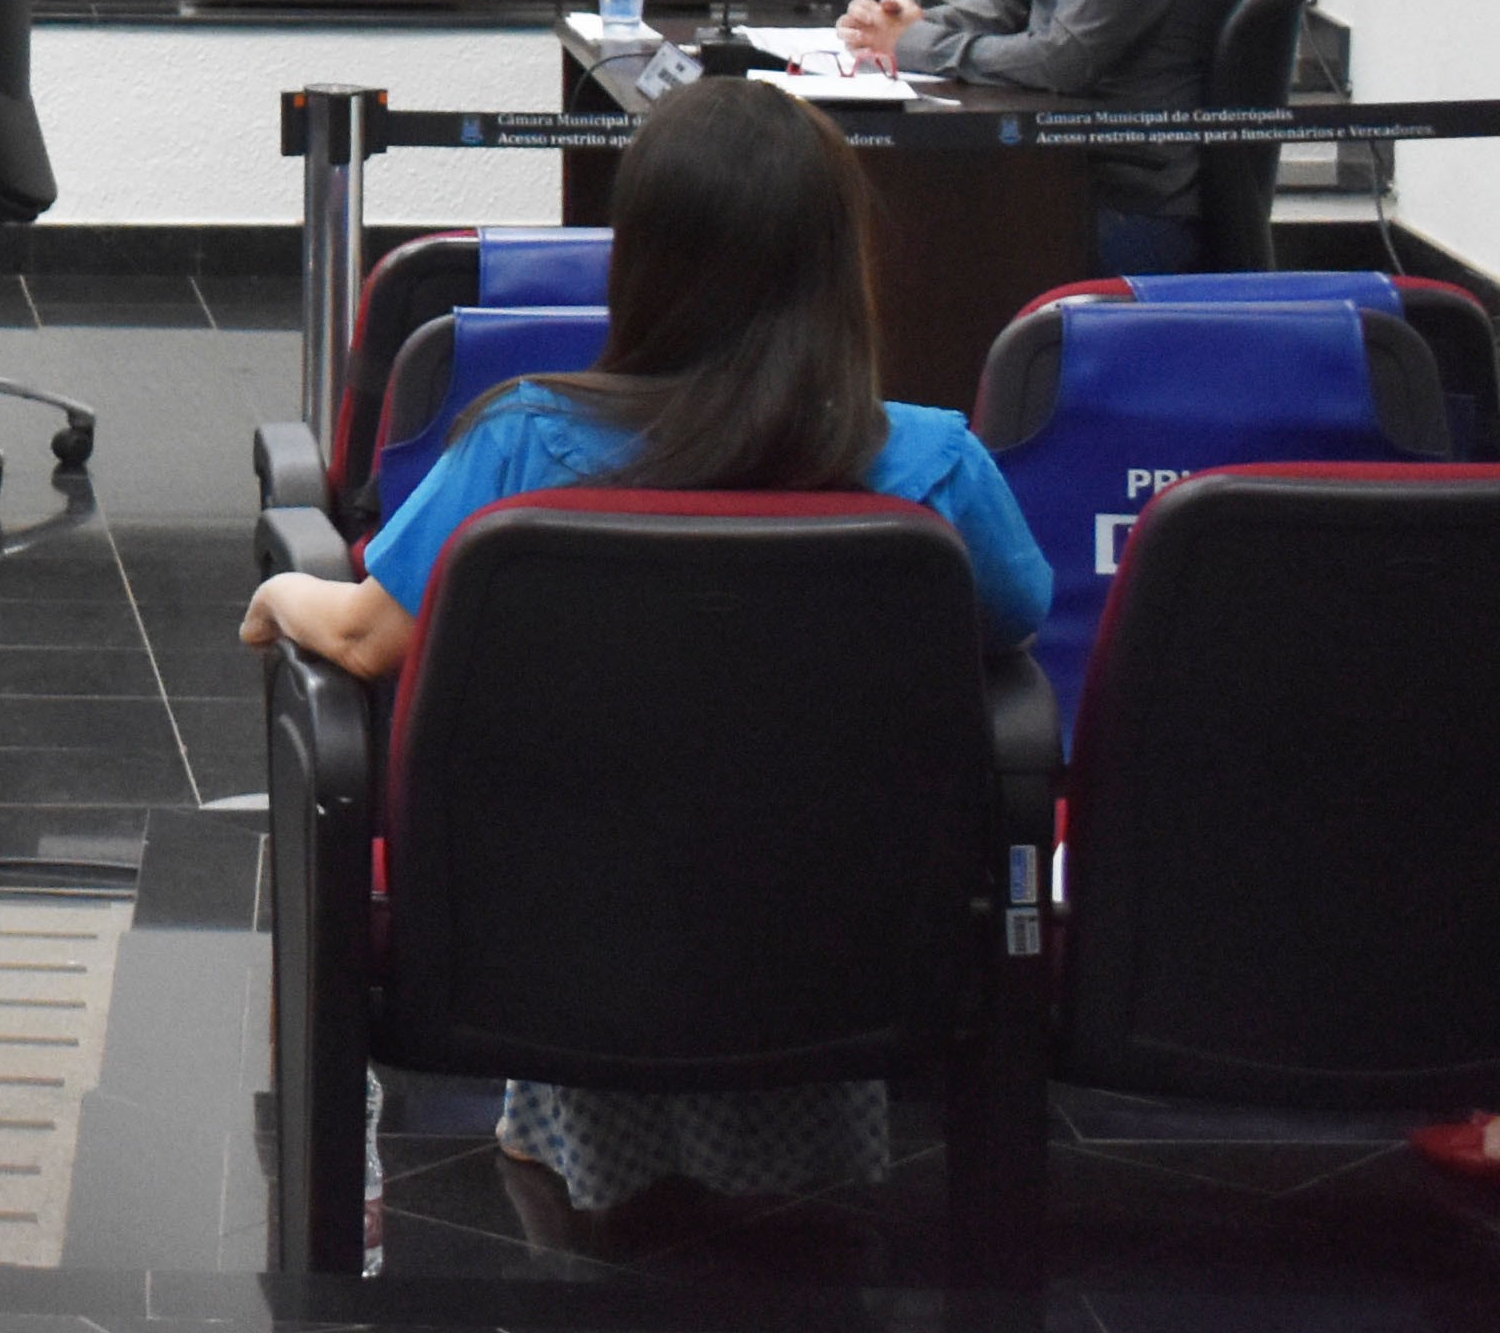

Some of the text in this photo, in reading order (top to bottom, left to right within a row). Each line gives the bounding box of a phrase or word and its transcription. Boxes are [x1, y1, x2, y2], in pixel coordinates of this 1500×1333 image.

[498, 113, 553, 126] Câmara
[556, 113, 629, 128] Municipal
[1036, 108, 1293, 126] Câmara Municipal de Cordeirópolis
[498, 132, 546, 145] Acesso
[550, 133, 606, 145] restrito
[1036, 131, 1086, 144] Acesso
[1089, 131, 1144, 143] restrito
[1149, 131, 1200, 144] apenas
[1204, 130, 1237, 144] para
[1241, 127, 1333, 140] funcionários
[1337, 129, 1346, 138] e
